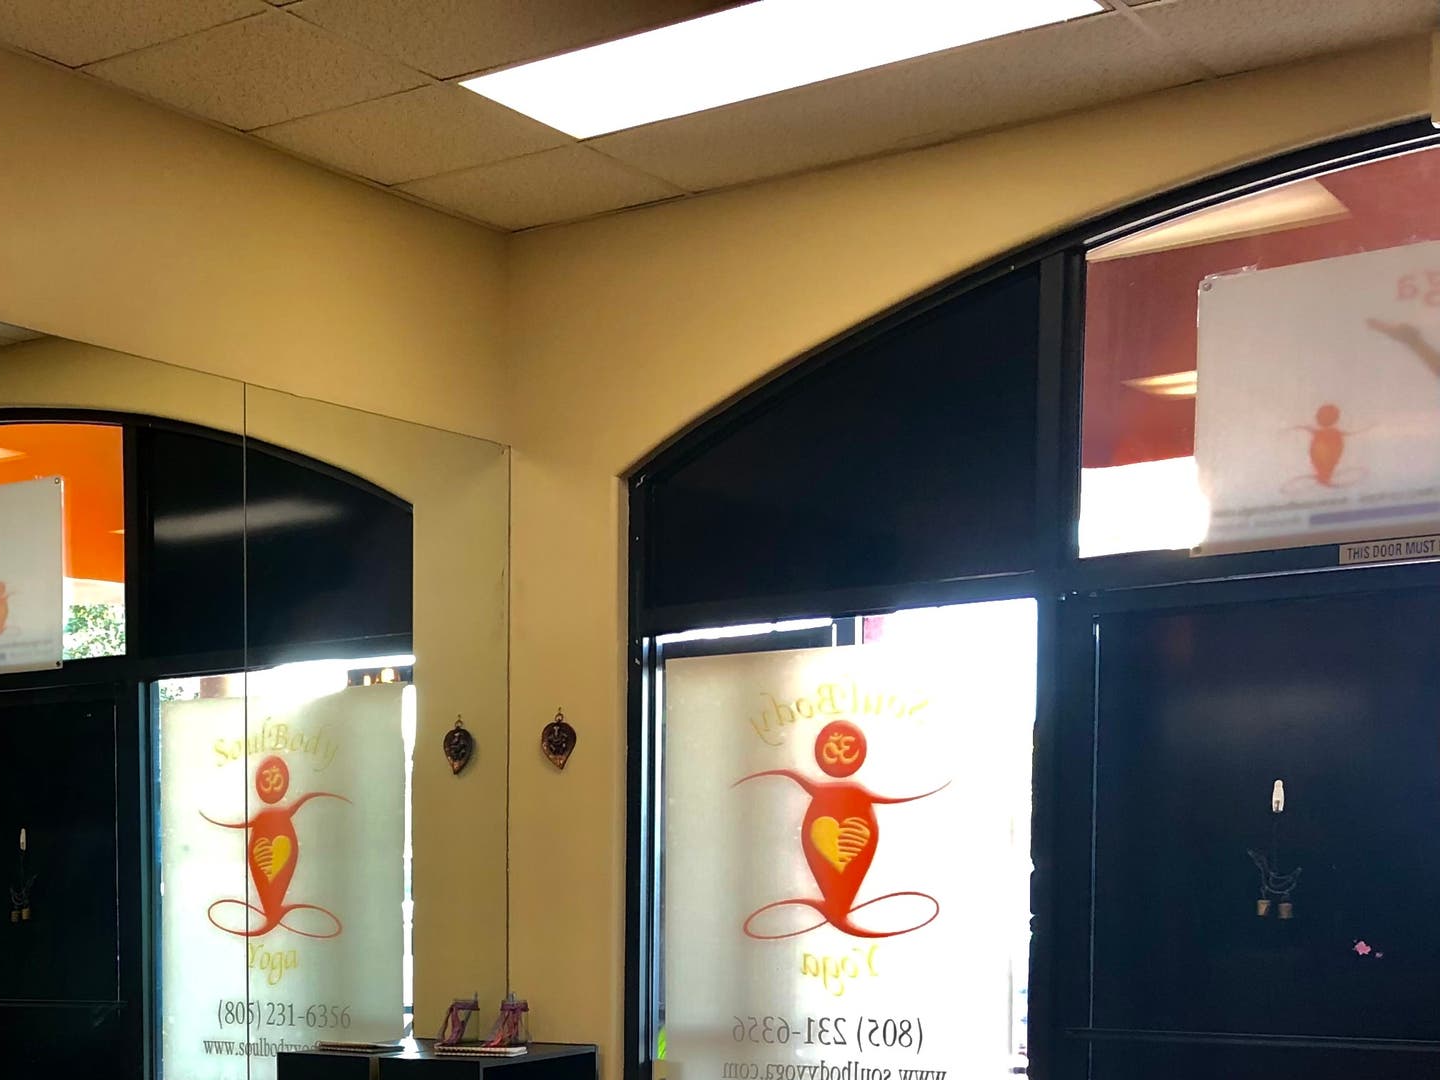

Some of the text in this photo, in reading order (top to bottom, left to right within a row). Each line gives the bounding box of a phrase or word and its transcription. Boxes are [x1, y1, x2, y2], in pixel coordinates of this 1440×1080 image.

[1347, 546, 1370, 561] THIS
[1373, 543, 1402, 558] DOOR
[1406, 540, 1436, 555] MUST
[247, 943, 298, 985] Yoga
[218, 1000, 351, 1029] (805) 231-6356
